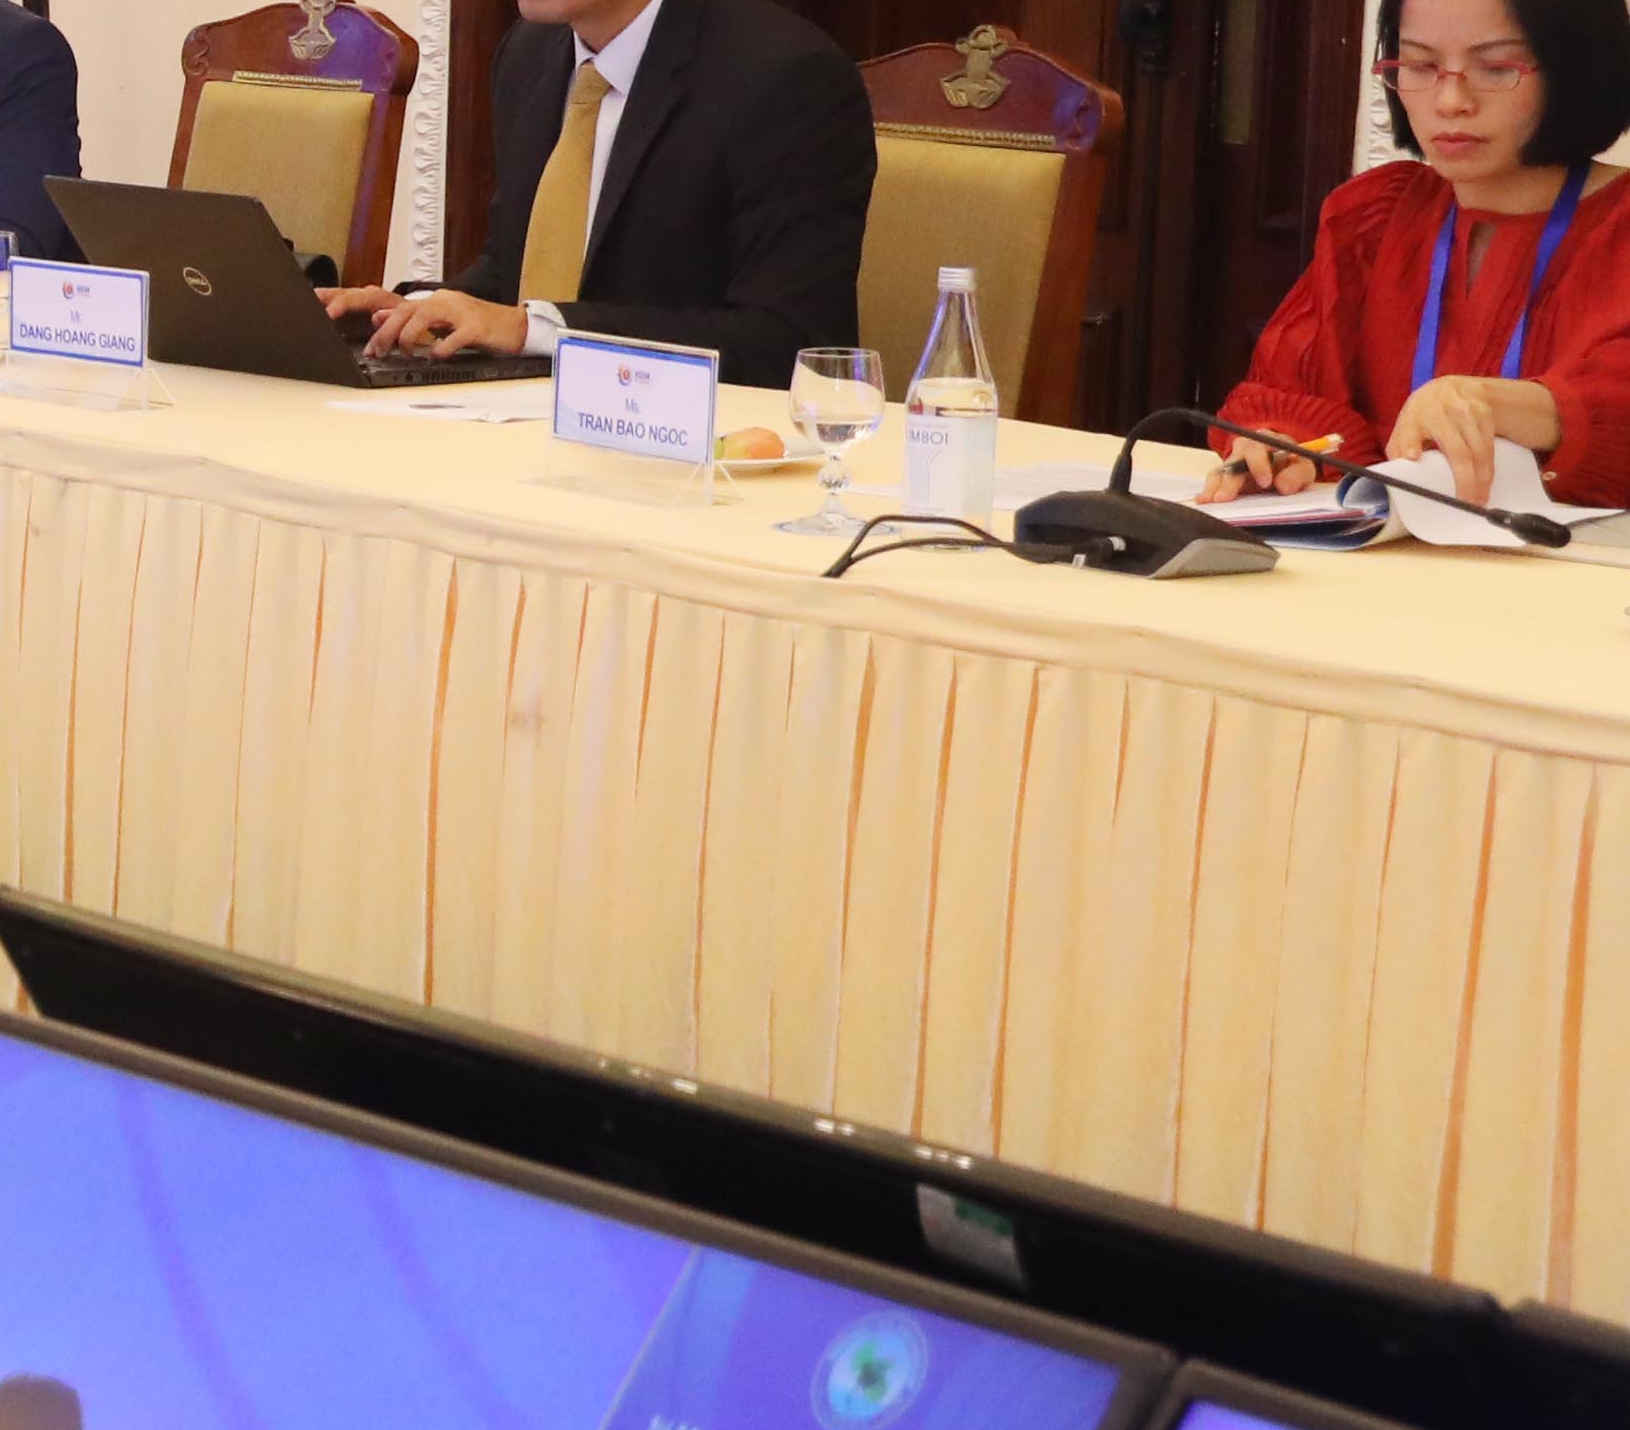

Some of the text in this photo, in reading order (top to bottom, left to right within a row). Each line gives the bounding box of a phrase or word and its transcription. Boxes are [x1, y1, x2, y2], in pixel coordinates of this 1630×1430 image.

[19, 324, 136, 352] DANG HOANG GIANG
[578, 412, 688, 447] TRAN BAO NGOC
